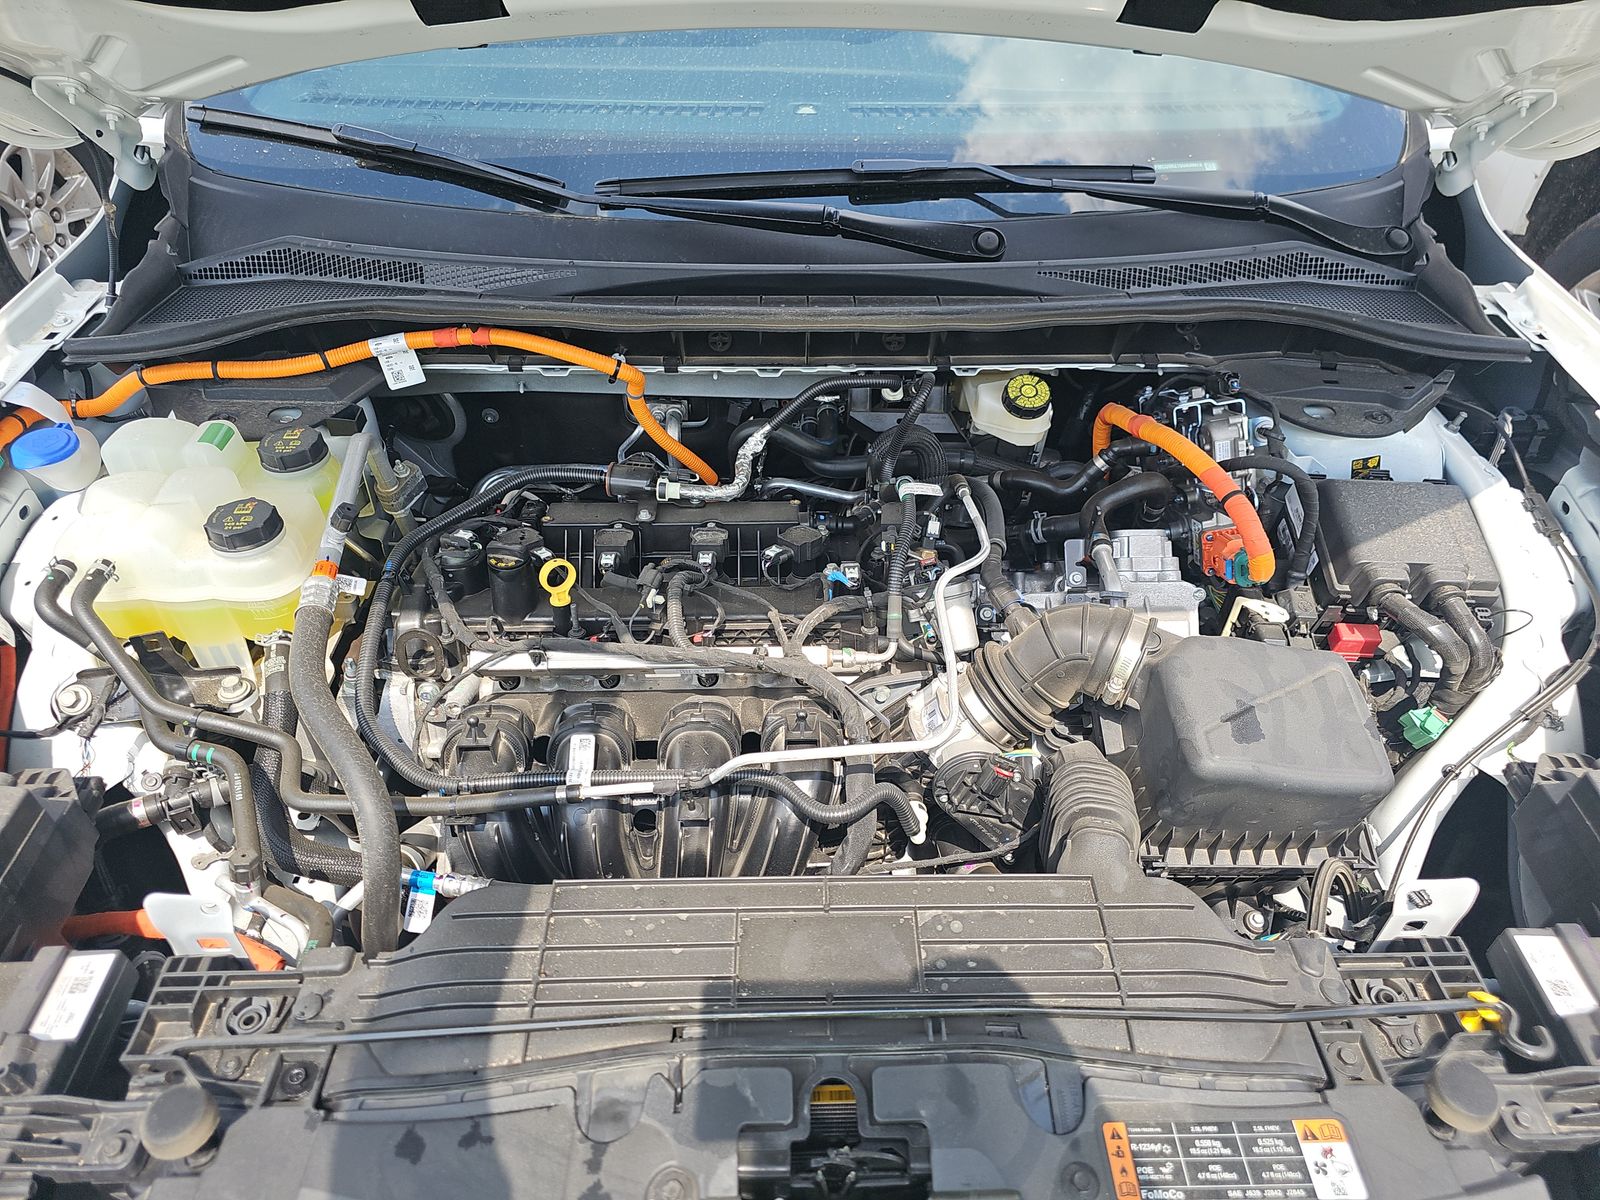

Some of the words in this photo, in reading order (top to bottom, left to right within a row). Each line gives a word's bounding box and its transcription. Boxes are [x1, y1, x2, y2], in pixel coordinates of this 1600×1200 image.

[1136, 1166, 1154, 1174] POE
[1140, 1189, 1185, 1199] FoMoCo
[1227, 1190, 1243, 1198] SAE
